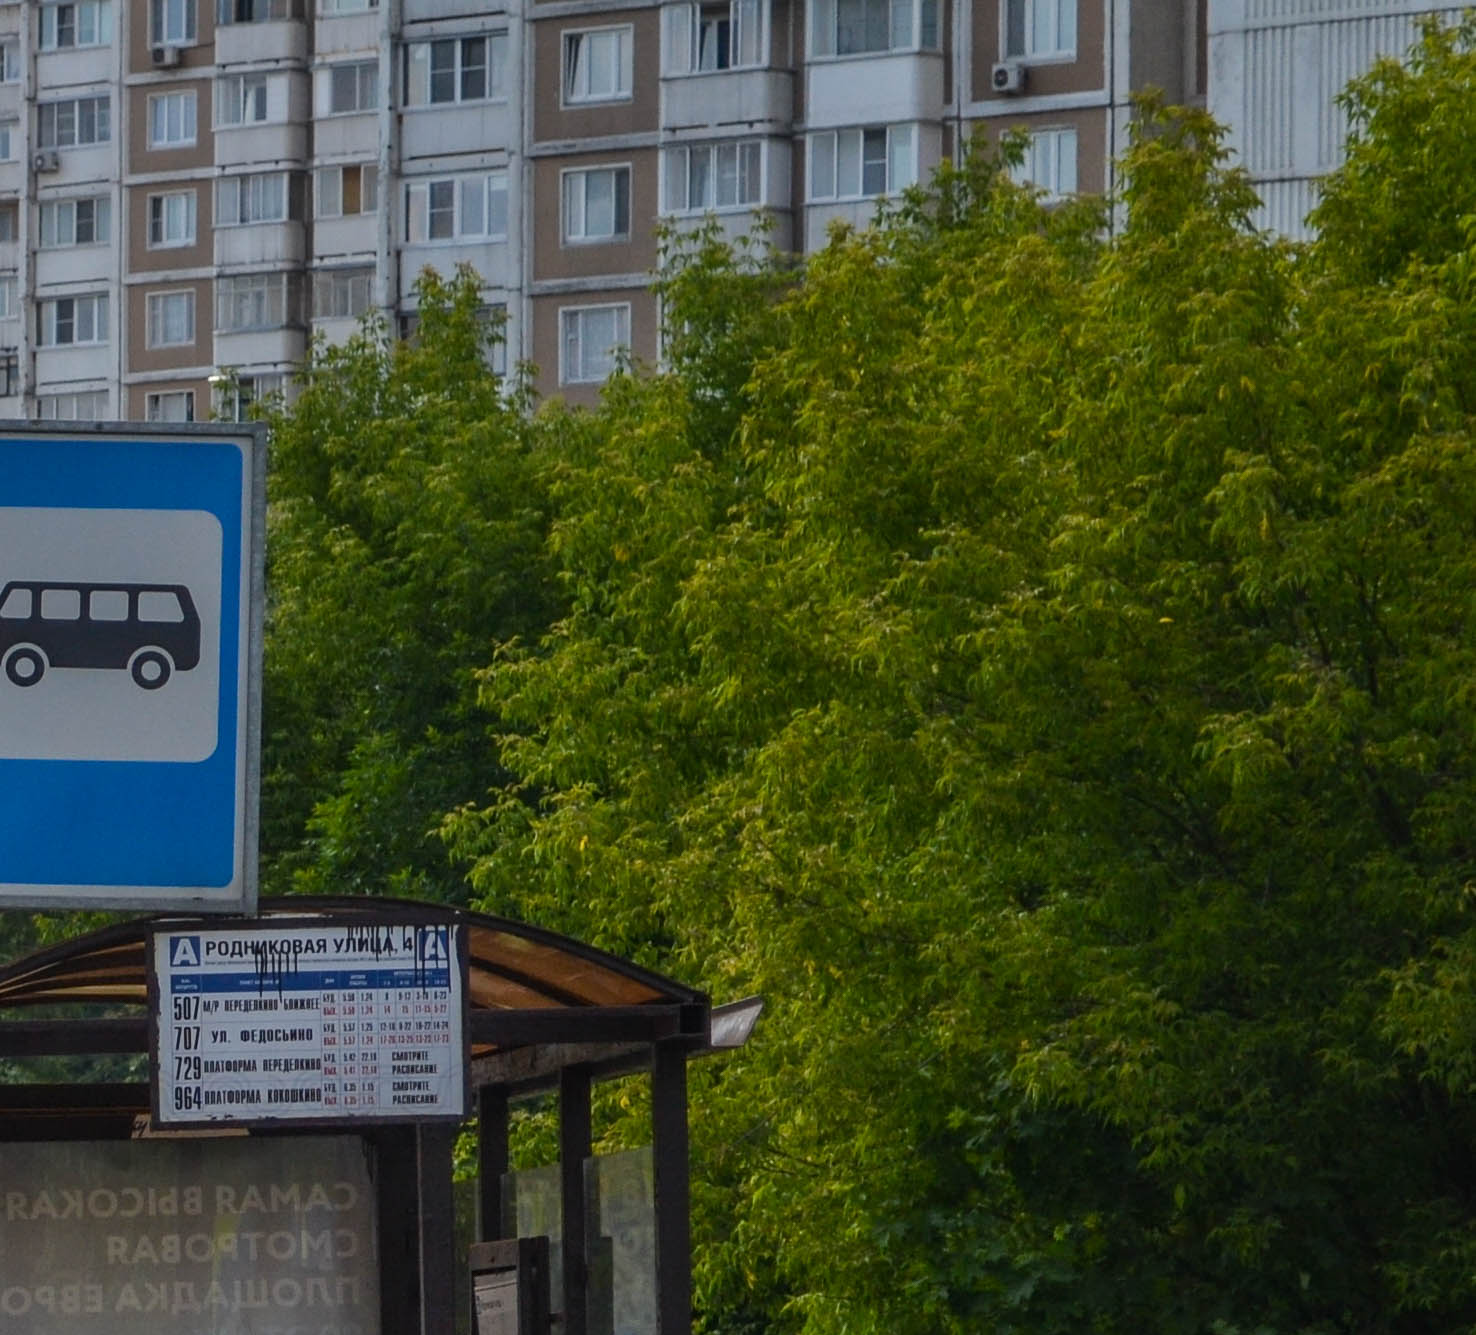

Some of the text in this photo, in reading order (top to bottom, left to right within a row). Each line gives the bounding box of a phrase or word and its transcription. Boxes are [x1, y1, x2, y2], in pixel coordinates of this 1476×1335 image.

[206, 938, 327, 957] РОДНИКОВАЯ
[174, 997, 200, 1020] 507
[224, 999, 278, 1012] ПЕРЕДЕЛКИНО
[283, 998, 320, 1010] БЛИЖНЕЕ
[174, 1027, 200, 1050] 707
[211, 1028, 313, 1043] УЛ. ФЕДОСЬИНО
[392, 1050, 429, 1061] СМОТРИТЕ
[174, 1056, 201, 1080] 729
[204, 1058, 321, 1073] ПЛАТФОРМА ПЕРЕДЕЛКИНО
[392, 1064, 438, 1075] РАСПИСАНИЕ
[174, 1086, 201, 1110] 964
[204, 1088, 322, 1104] ПЛАТФОРМА КОКОШКИНО
[392, 1095, 438, 1105] РАСПИСАНИЕ
